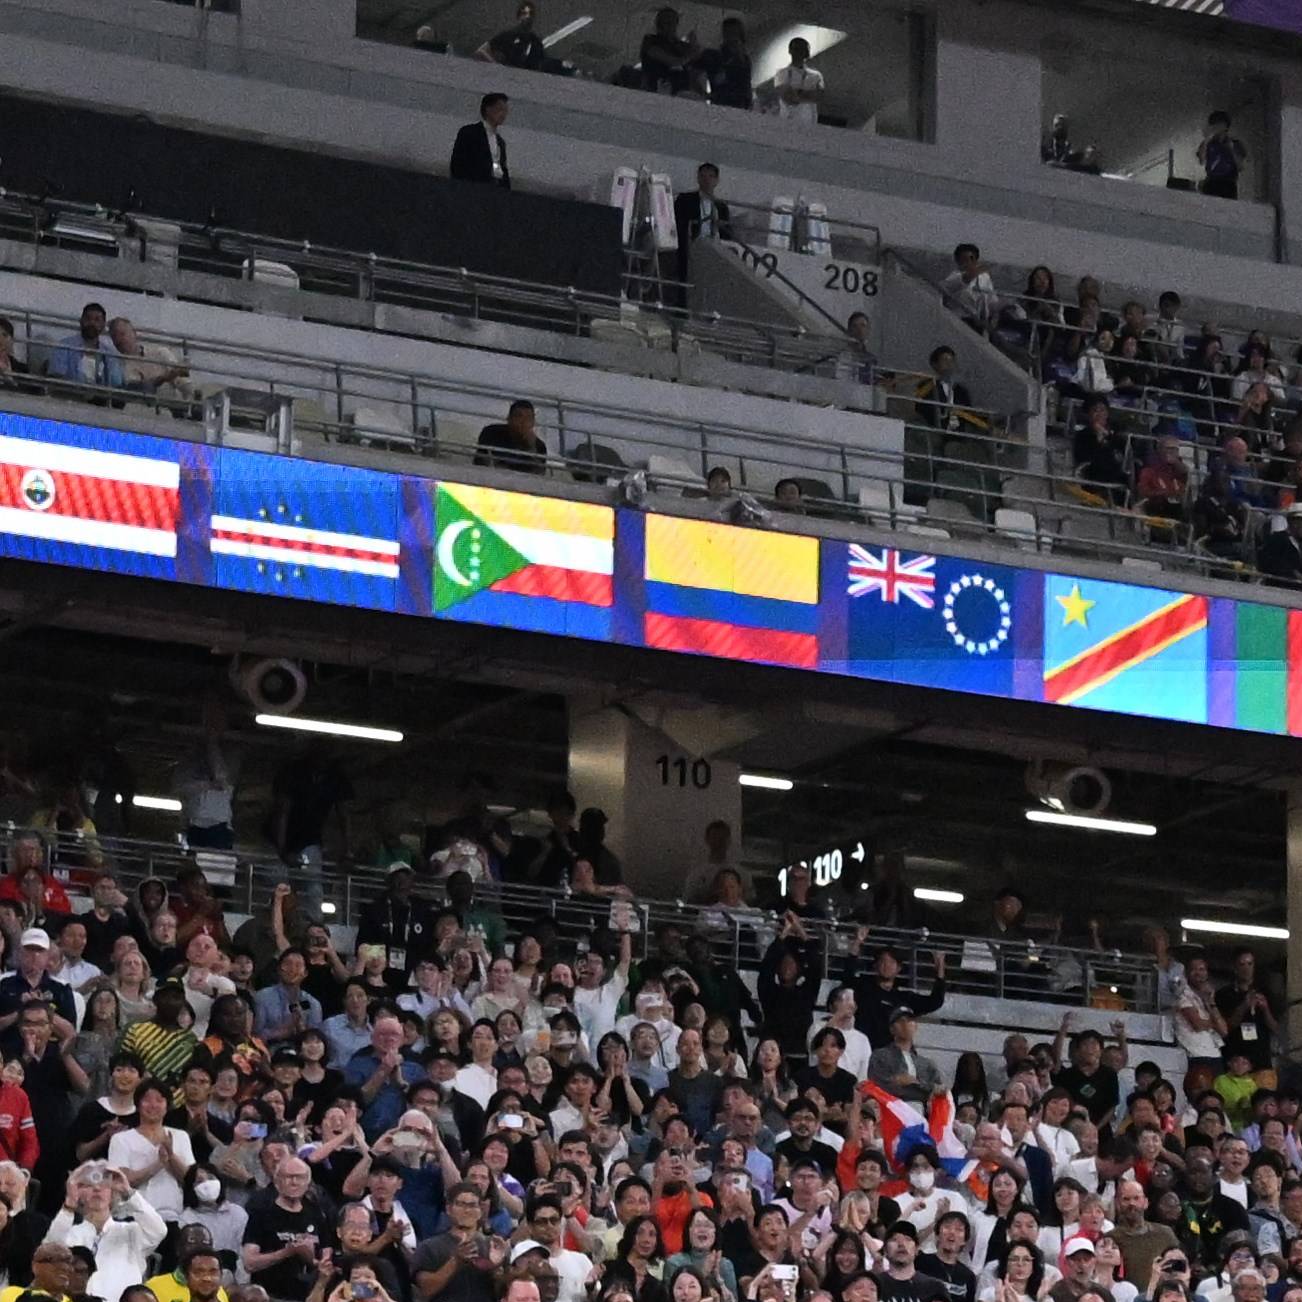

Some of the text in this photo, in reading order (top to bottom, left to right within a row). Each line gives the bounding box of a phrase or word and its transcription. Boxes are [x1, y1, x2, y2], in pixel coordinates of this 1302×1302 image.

[824, 263, 878, 297] 208
[656, 755, 711, 789] 110
[812, 848, 844, 888] 110
